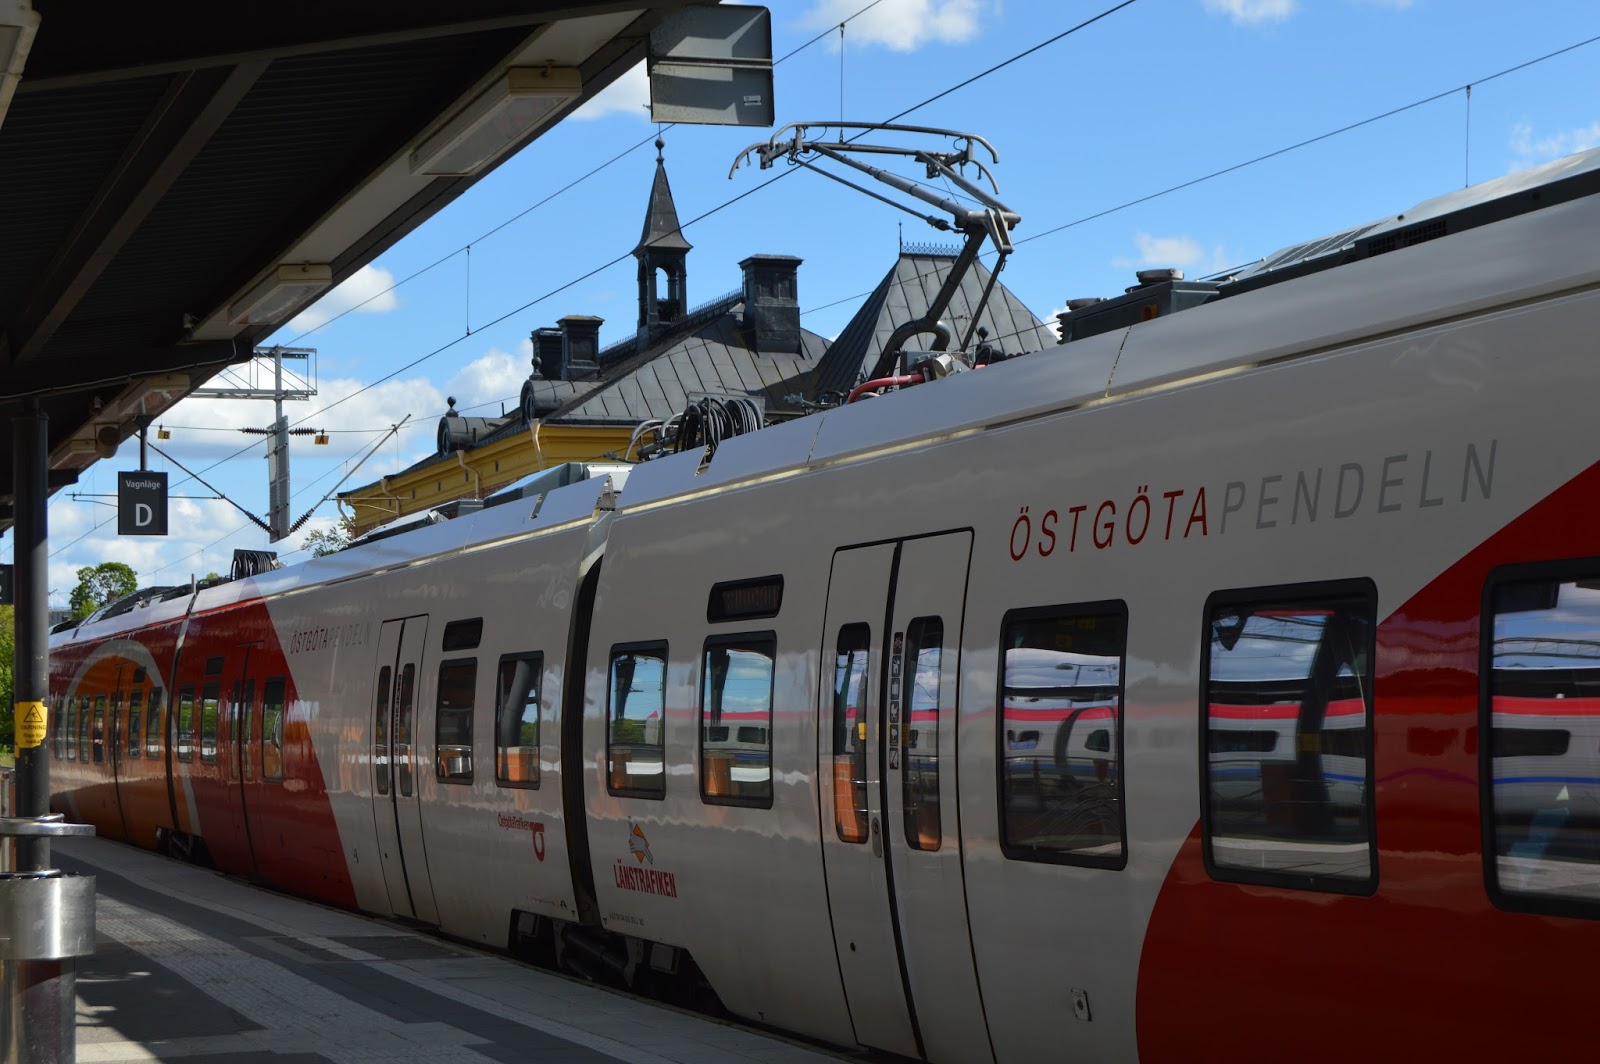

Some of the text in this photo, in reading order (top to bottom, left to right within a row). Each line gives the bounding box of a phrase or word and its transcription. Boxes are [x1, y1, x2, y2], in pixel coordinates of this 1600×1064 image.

[125, 480, 161, 489] Vagnläge
[1009, 439, 1497, 561] ÖSTGÖTAPENDELN
[135, 503, 153, 526] D
[290, 621, 373, 655] ÖSTGÖTAPENDELN
[613, 858, 677, 898] LÄNSTRAFIKEN
